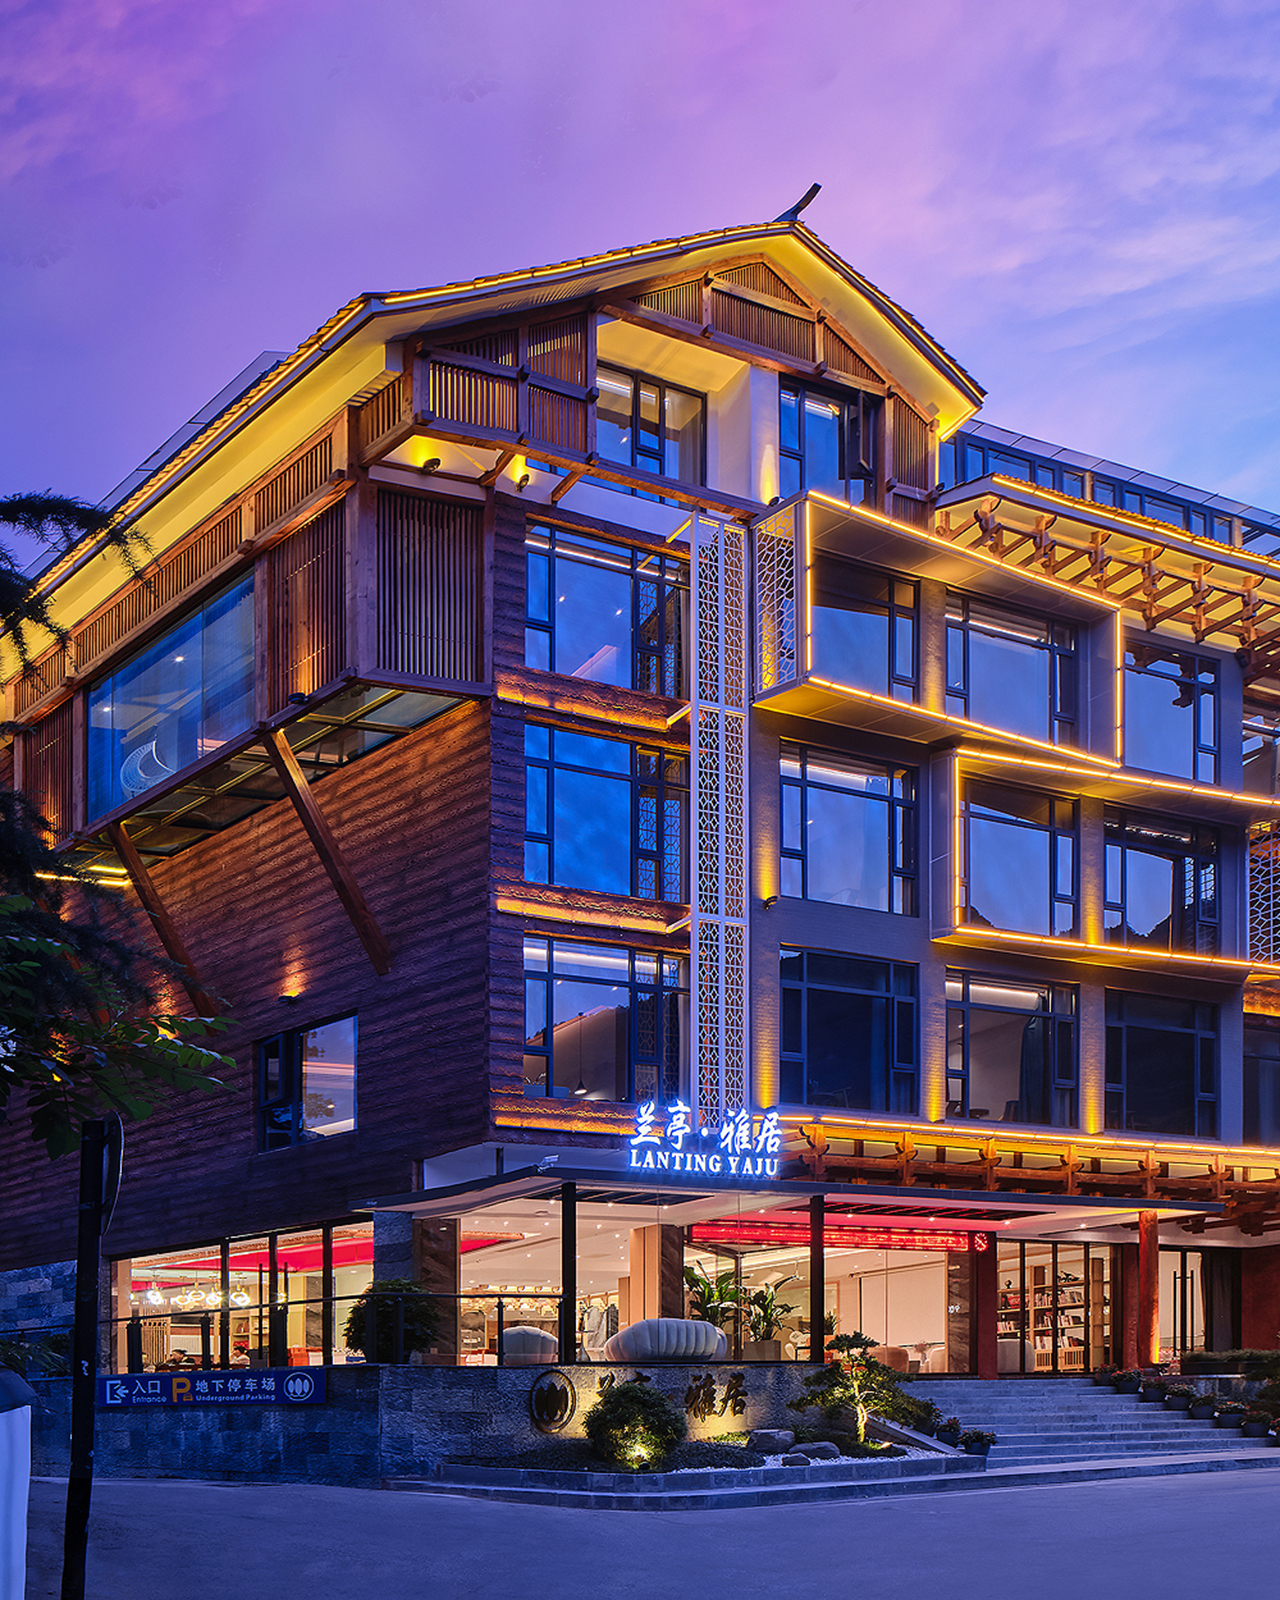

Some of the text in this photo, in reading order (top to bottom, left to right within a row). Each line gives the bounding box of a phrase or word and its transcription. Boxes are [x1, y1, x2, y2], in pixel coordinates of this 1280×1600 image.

[630, 1099, 783, 1155] 兰亭·雅居
[630, 1148, 779, 1176] LANTING YAJU
[132, 1377, 276, 1394] 入口 地下停车场
[132, 1393, 276, 1404] Entrance Underground Parking
